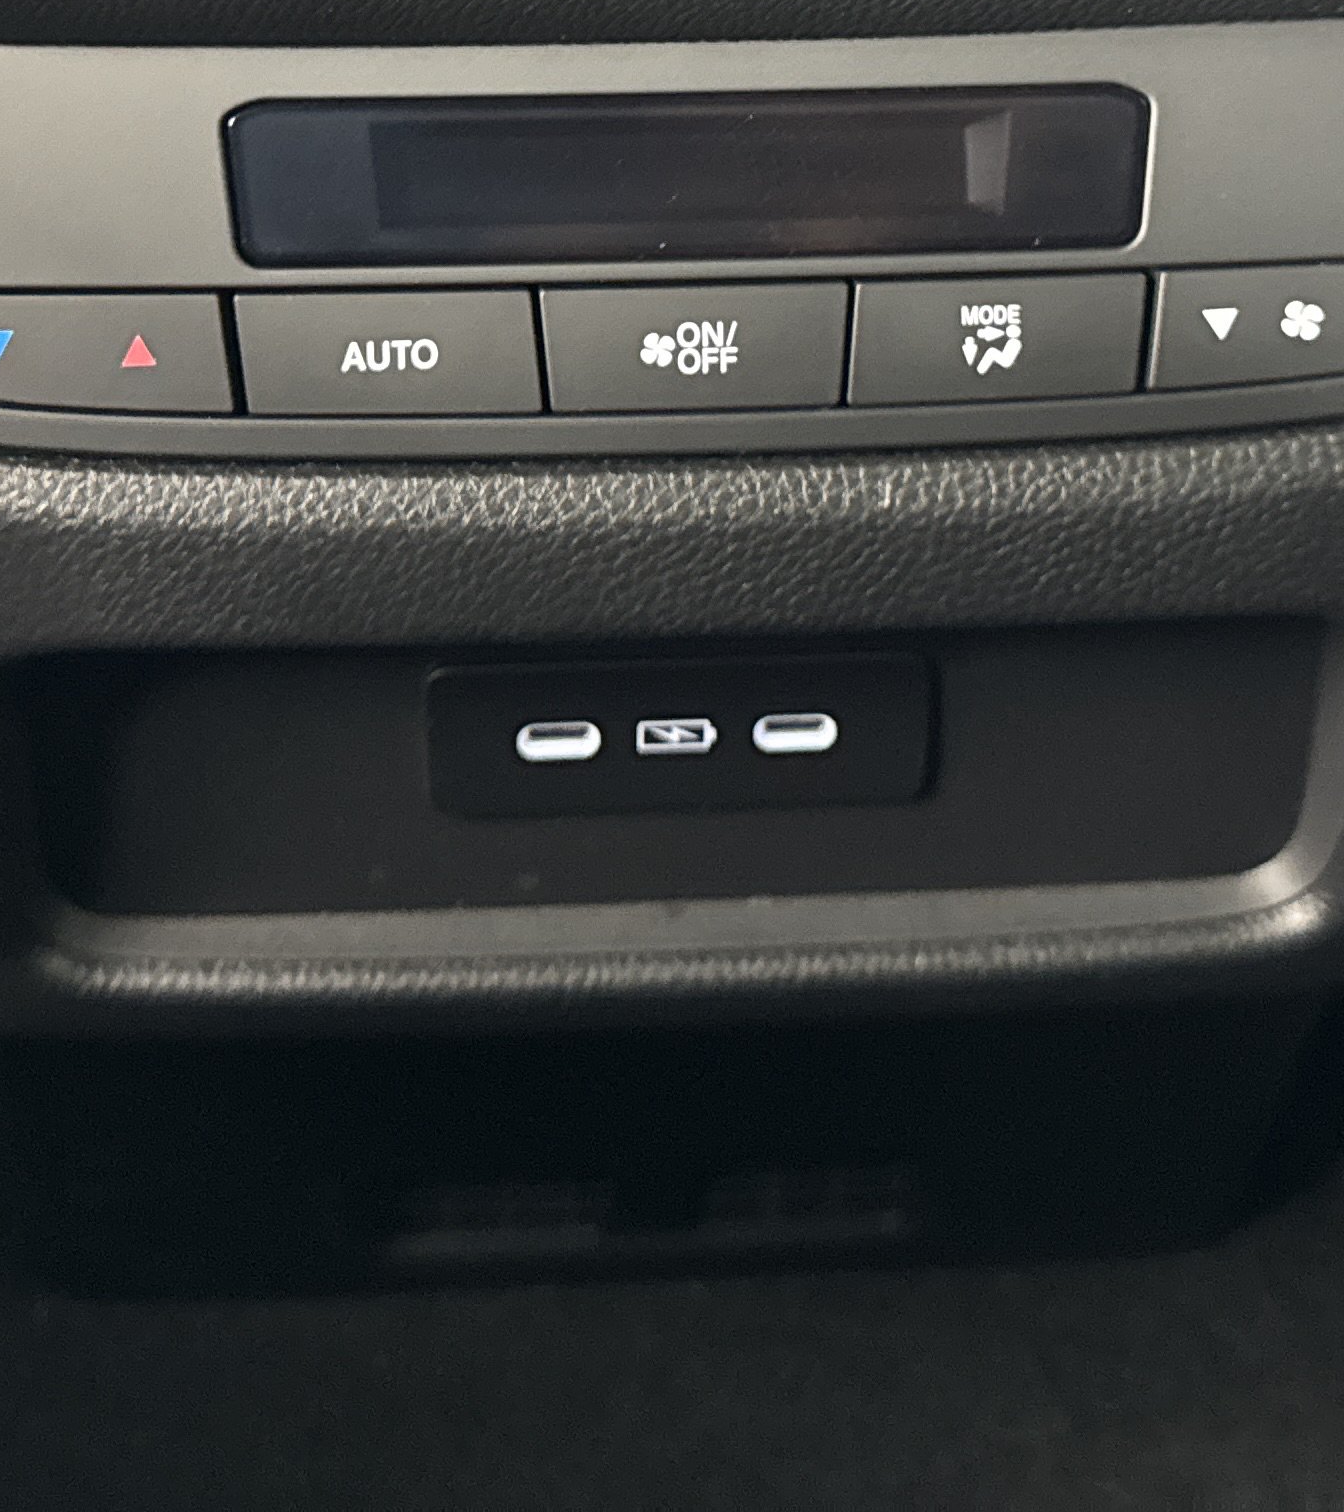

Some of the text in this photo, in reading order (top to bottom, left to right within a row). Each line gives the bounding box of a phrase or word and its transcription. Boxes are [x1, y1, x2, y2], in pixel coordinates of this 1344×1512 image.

[960, 304, 1022, 325] MODE
[675, 320, 738, 348] ON/
[340, 338, 439, 373] AUTO
[675, 346, 738, 375] OFF
